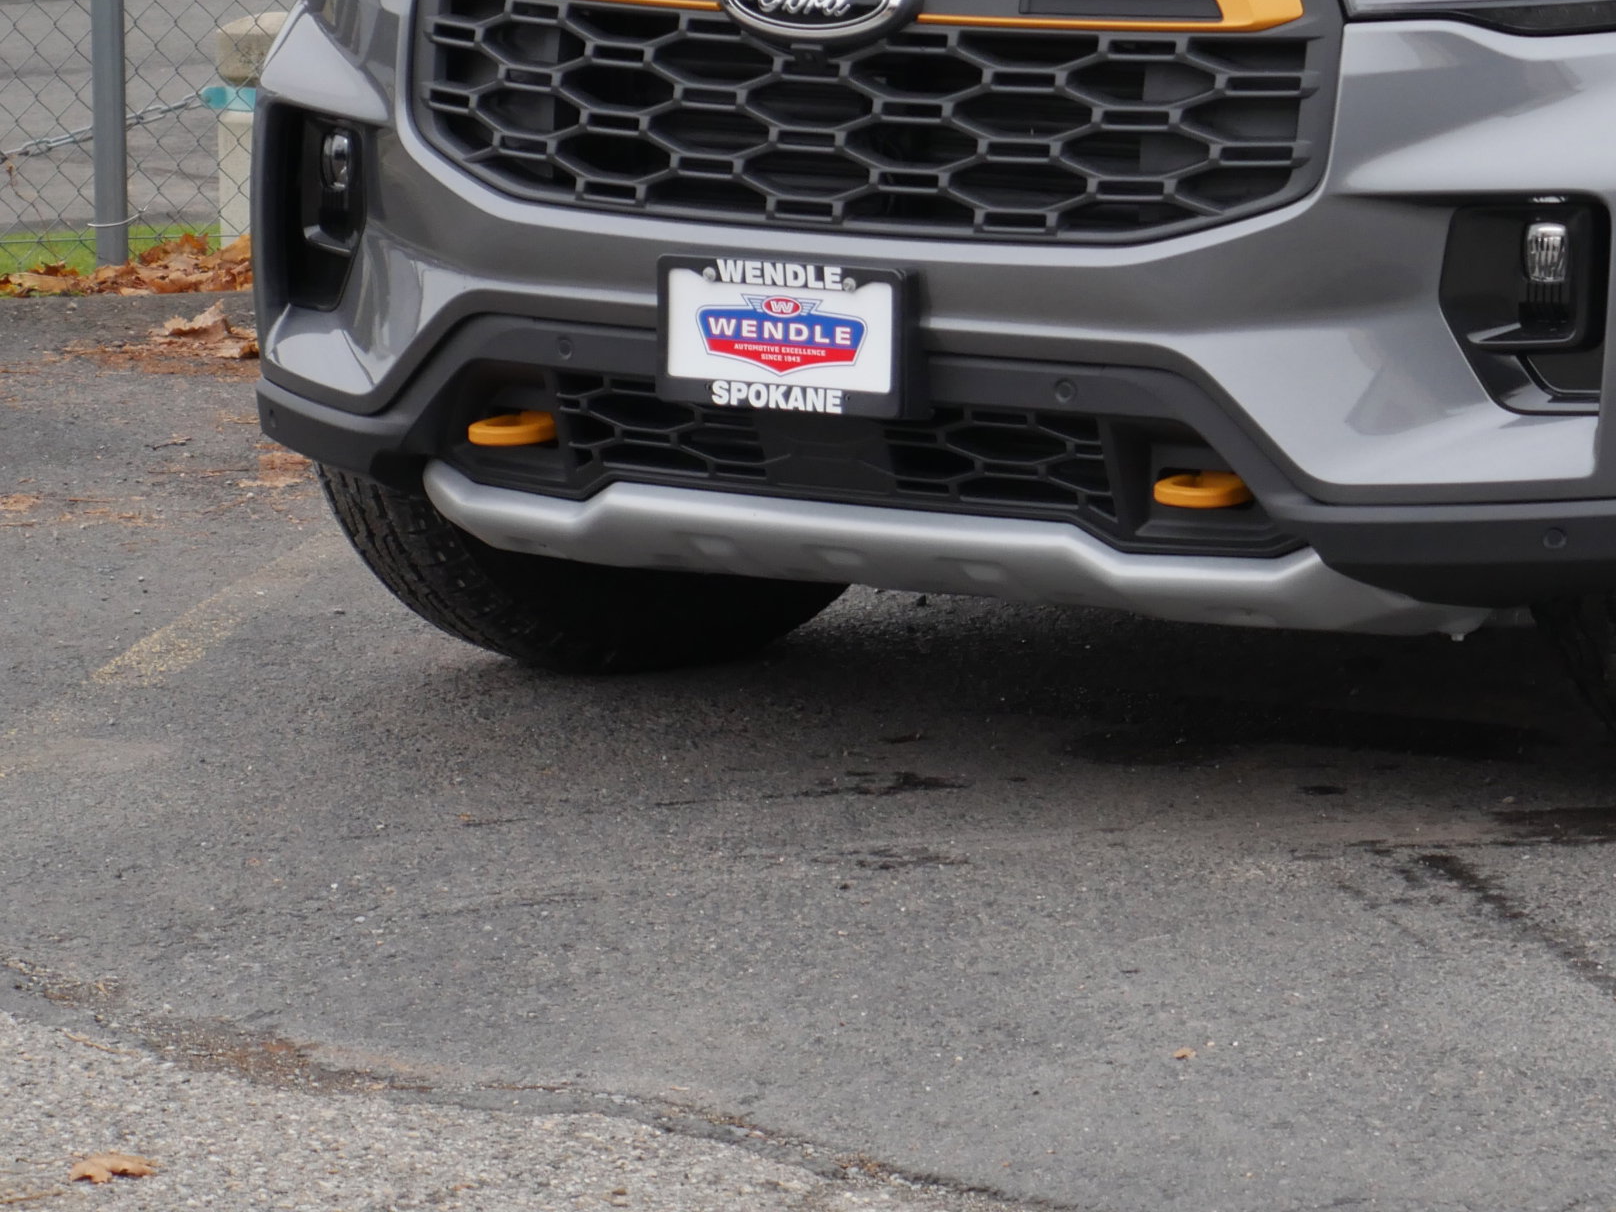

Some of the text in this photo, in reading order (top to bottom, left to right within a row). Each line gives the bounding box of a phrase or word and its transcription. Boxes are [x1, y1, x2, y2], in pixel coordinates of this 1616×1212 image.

[716, 258, 843, 291] WENDLE
[769, 299, 795, 315] W
[708, 317, 851, 346] WENDLE
[733, 343, 827, 357] AUTOMOTIVE EXCELLENCE
[760, 353, 783, 363] SINCE
[711, 380, 843, 415] SPOKANE
